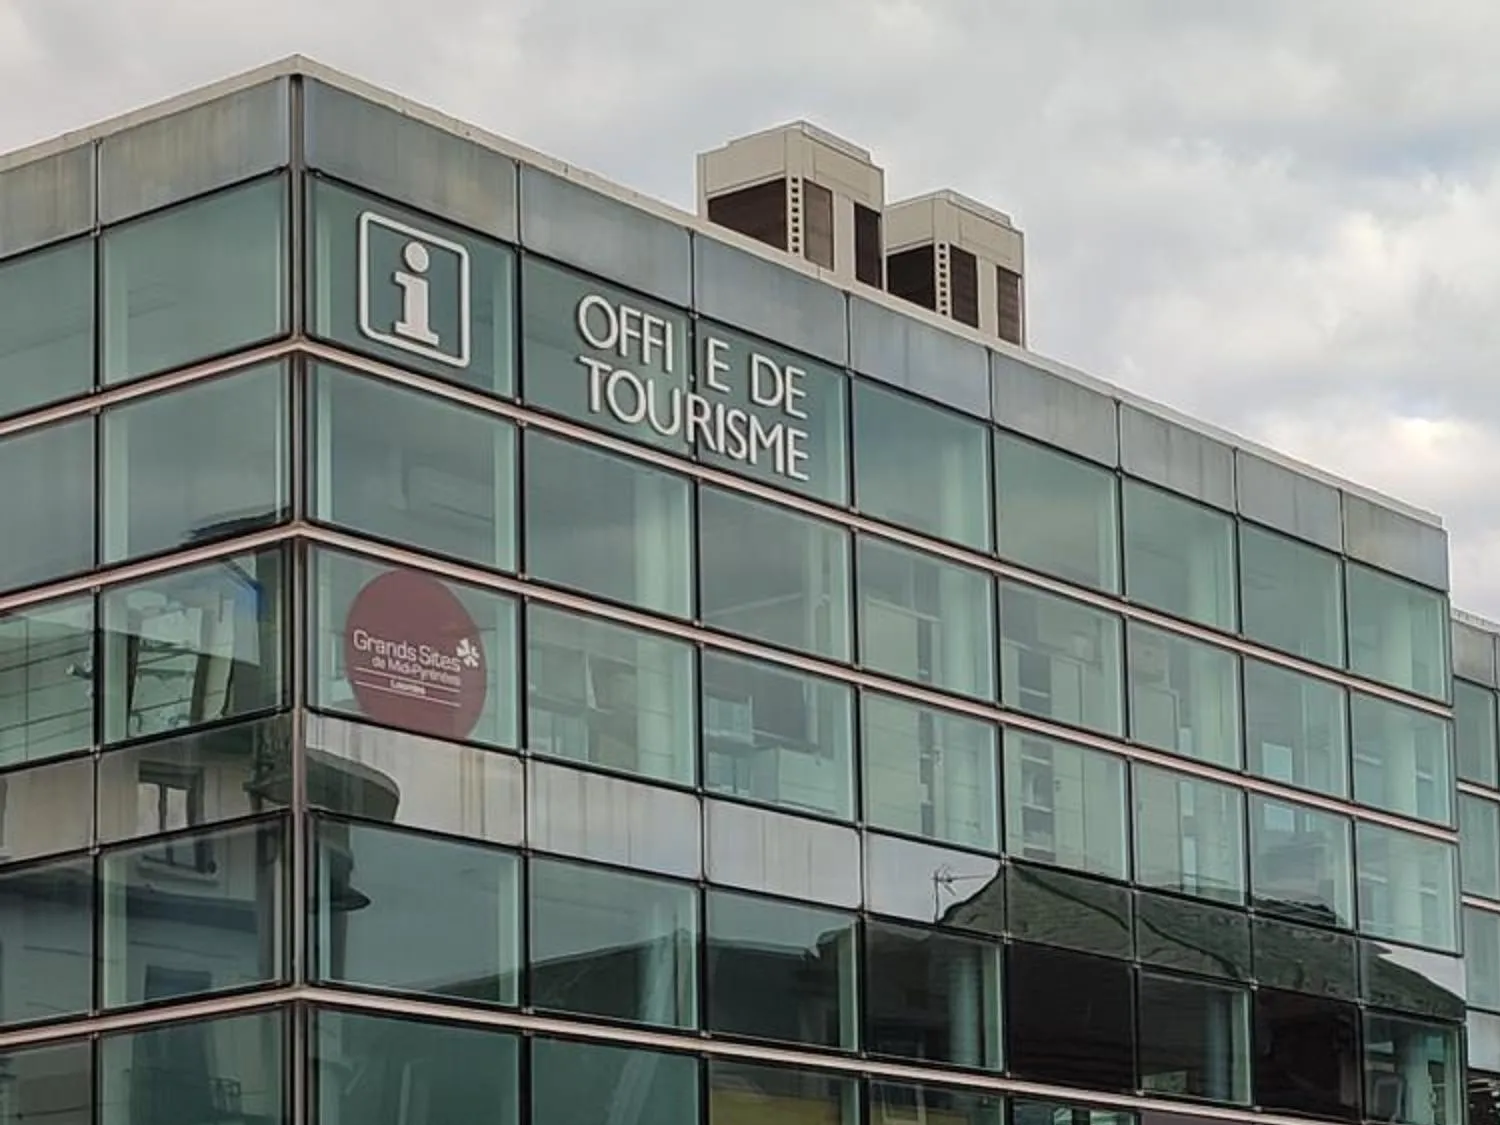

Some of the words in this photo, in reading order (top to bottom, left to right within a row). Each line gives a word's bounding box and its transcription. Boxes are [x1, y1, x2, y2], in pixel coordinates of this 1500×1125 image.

[577, 294, 730, 393] OFFIE
[751, 352, 808, 419] DE
[579, 356, 809, 481] TOURISME
[353, 629, 417, 662] Grands
[419, 645, 461, 673] Sites
